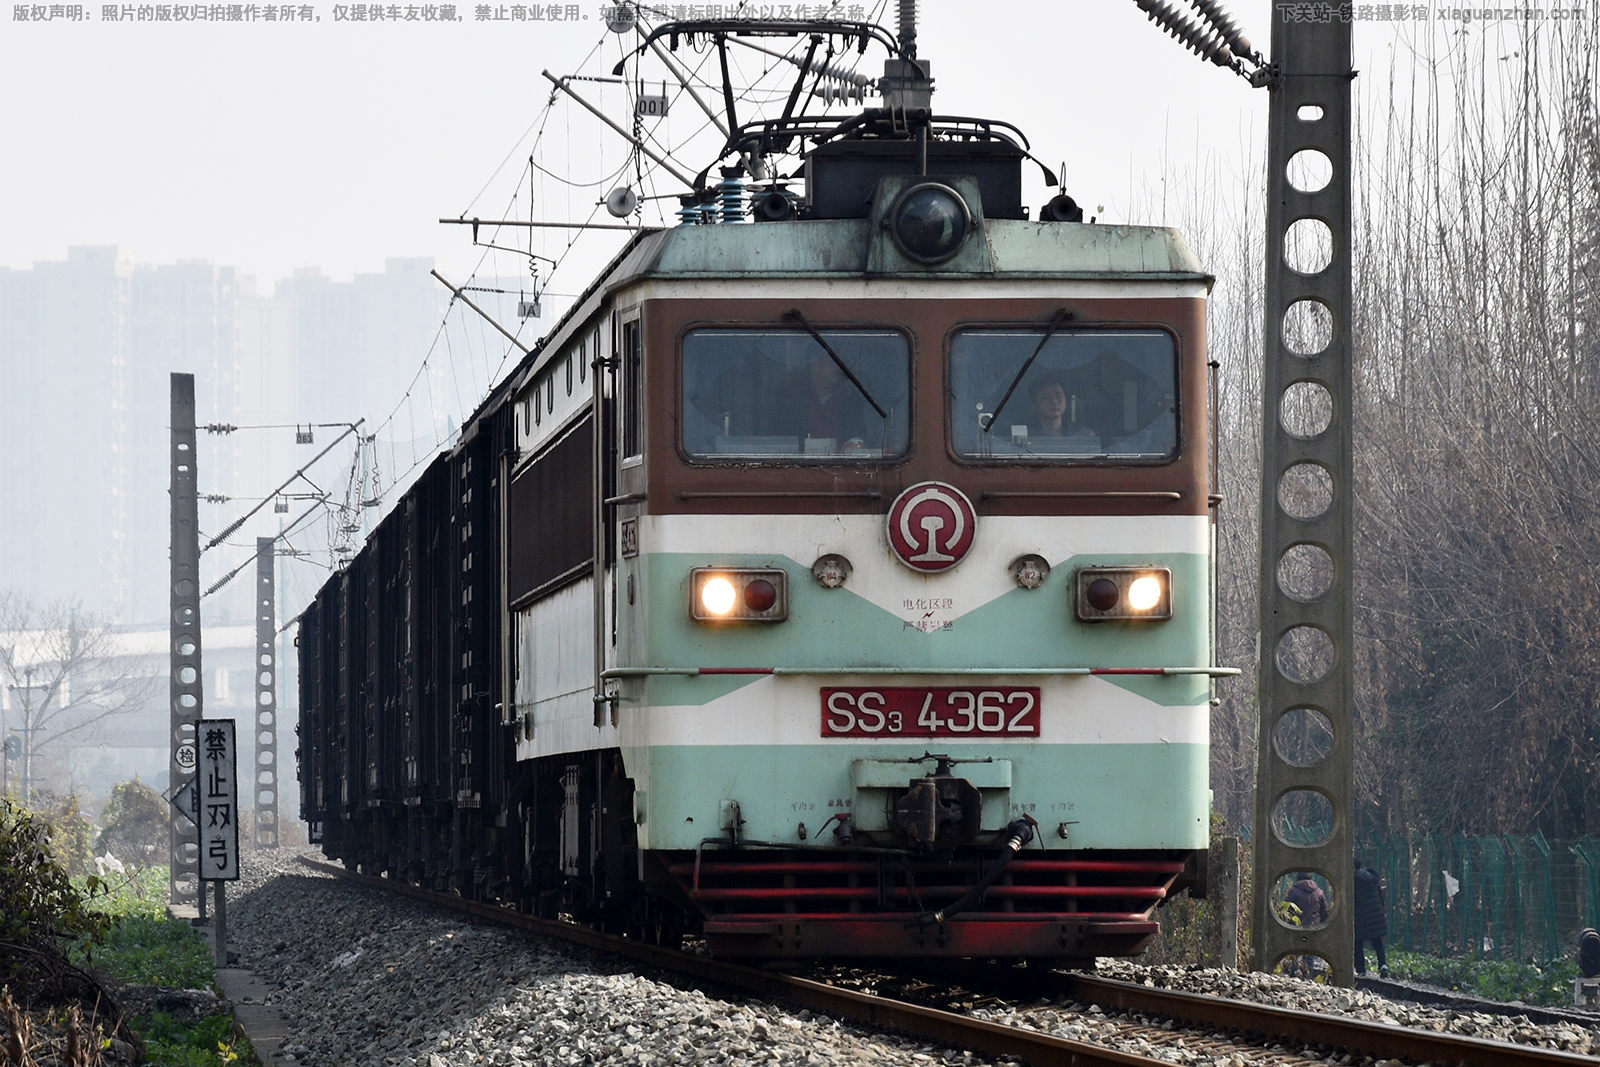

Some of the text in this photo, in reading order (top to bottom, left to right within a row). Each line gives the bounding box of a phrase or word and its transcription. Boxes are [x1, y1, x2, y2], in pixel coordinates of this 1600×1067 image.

[639, 100, 664, 115] 001
[296, 434, 313, 444] 063
[1025, 571, 1036, 580] W2
[903, 598, 953, 610] 电化区段
[917, 691, 1035, 732] 4362
[179, 748, 195, 763] 检
[204, 728, 231, 871] 禁止双弓
